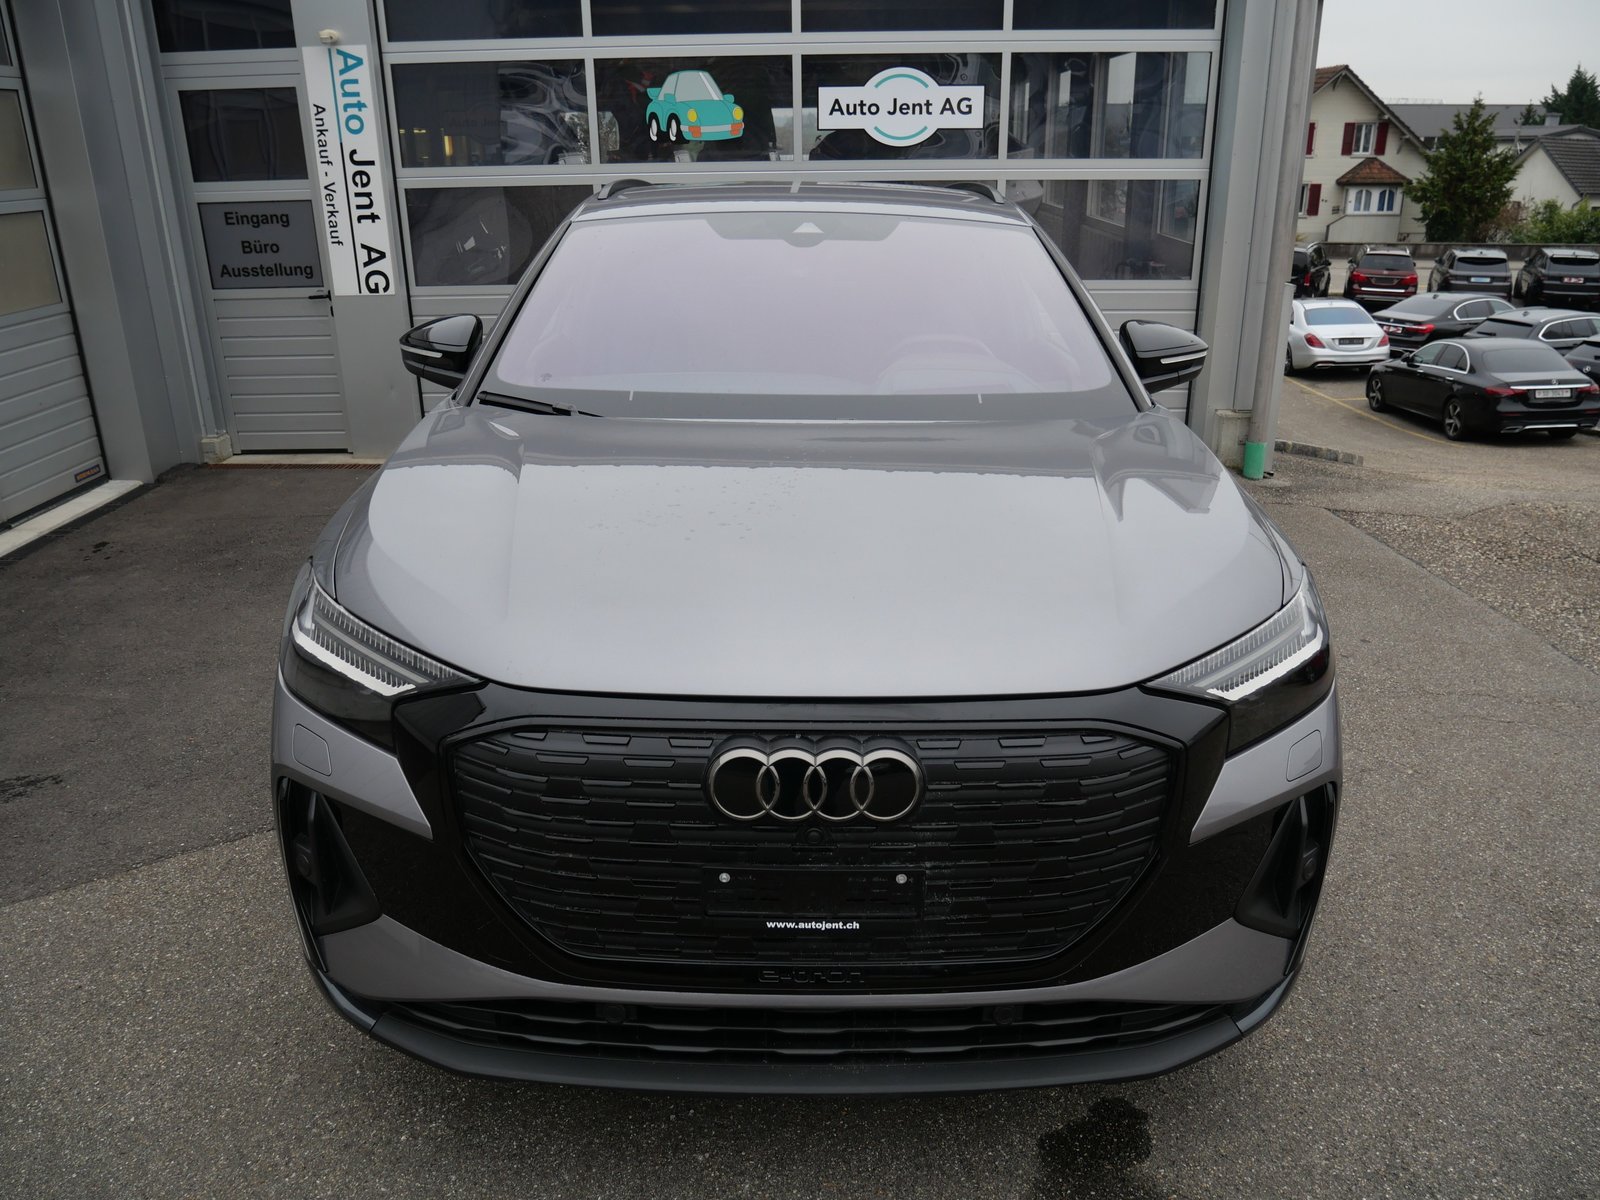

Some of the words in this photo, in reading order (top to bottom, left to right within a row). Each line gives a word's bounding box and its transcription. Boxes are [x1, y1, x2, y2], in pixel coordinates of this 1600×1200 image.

[336, 48, 368, 135] Auto
[828, 98, 880, 116] Auto
[886, 97, 932, 116] Jent
[939, 97, 973, 116] AG
[313, 103, 334, 166] Ankauf
[348, 148, 381, 224] Jent
[223, 211, 290, 228] Eingang
[323, 181, 344, 246] Verkauf
[240, 240, 280, 255] Büro
[220, 262, 314, 279] Ausstellung
[360, 242, 390, 294] AG
[766, 921, 860, 931] www.autojent.ch
